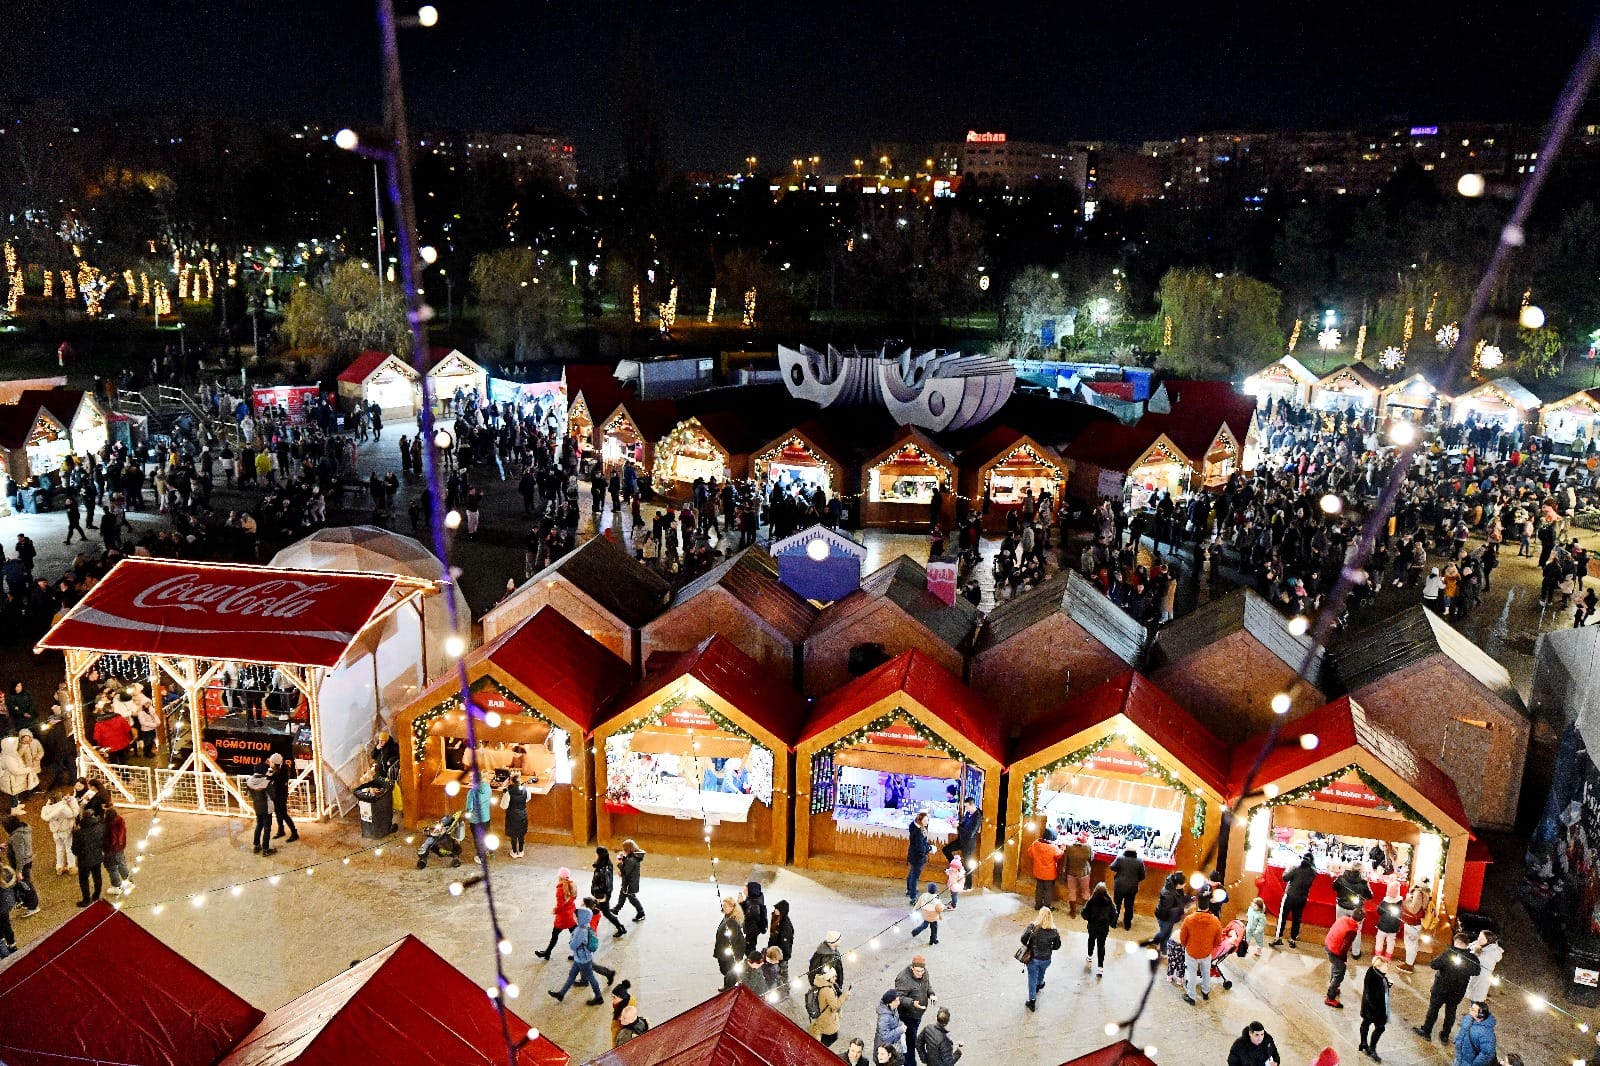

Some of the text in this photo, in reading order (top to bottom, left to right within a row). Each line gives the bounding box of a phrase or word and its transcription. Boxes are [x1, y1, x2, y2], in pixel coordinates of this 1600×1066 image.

[133, 573, 340, 618] Coca-Cola
[215, 739, 271, 751] ROMOTION
[232, 755, 292, 768] SIMULR
